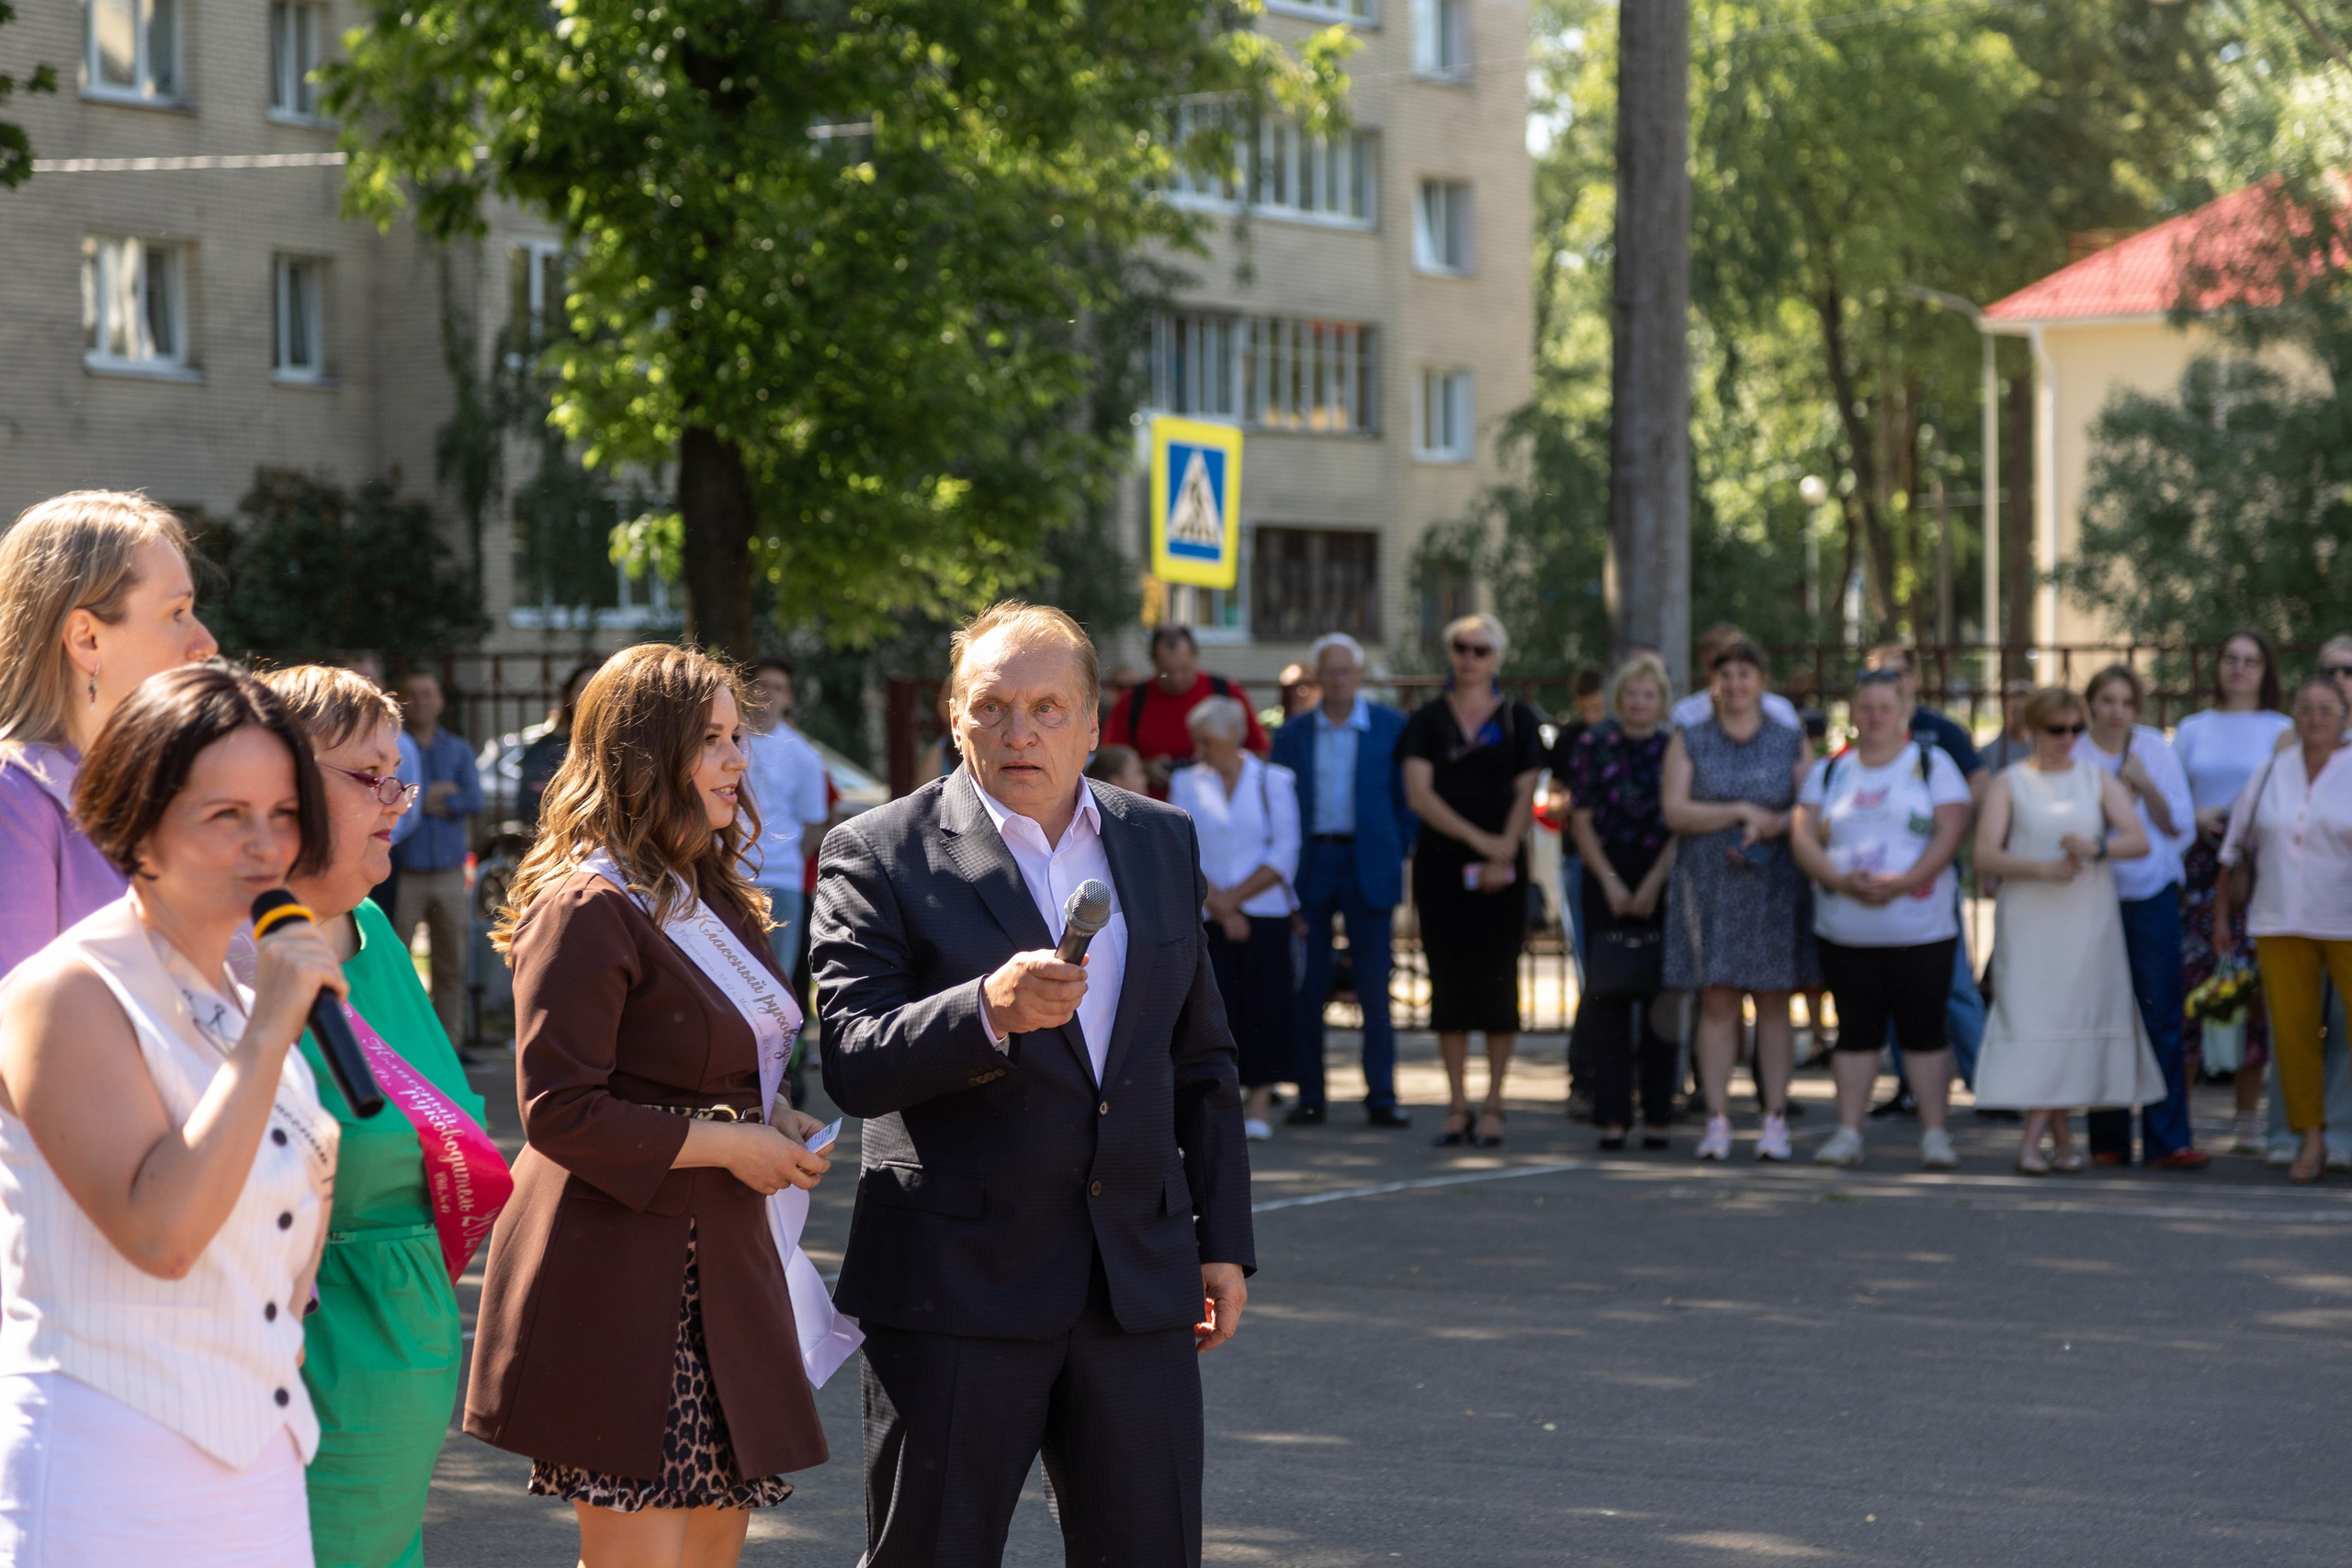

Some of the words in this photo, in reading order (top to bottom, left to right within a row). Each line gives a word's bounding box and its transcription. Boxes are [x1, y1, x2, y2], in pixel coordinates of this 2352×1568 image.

[691, 908, 767, 994] Классный
[363, 1037, 458, 1129] Классный
[398, 1089, 475, 1213] руководитель
[461, 1207, 502, 1257] 202
